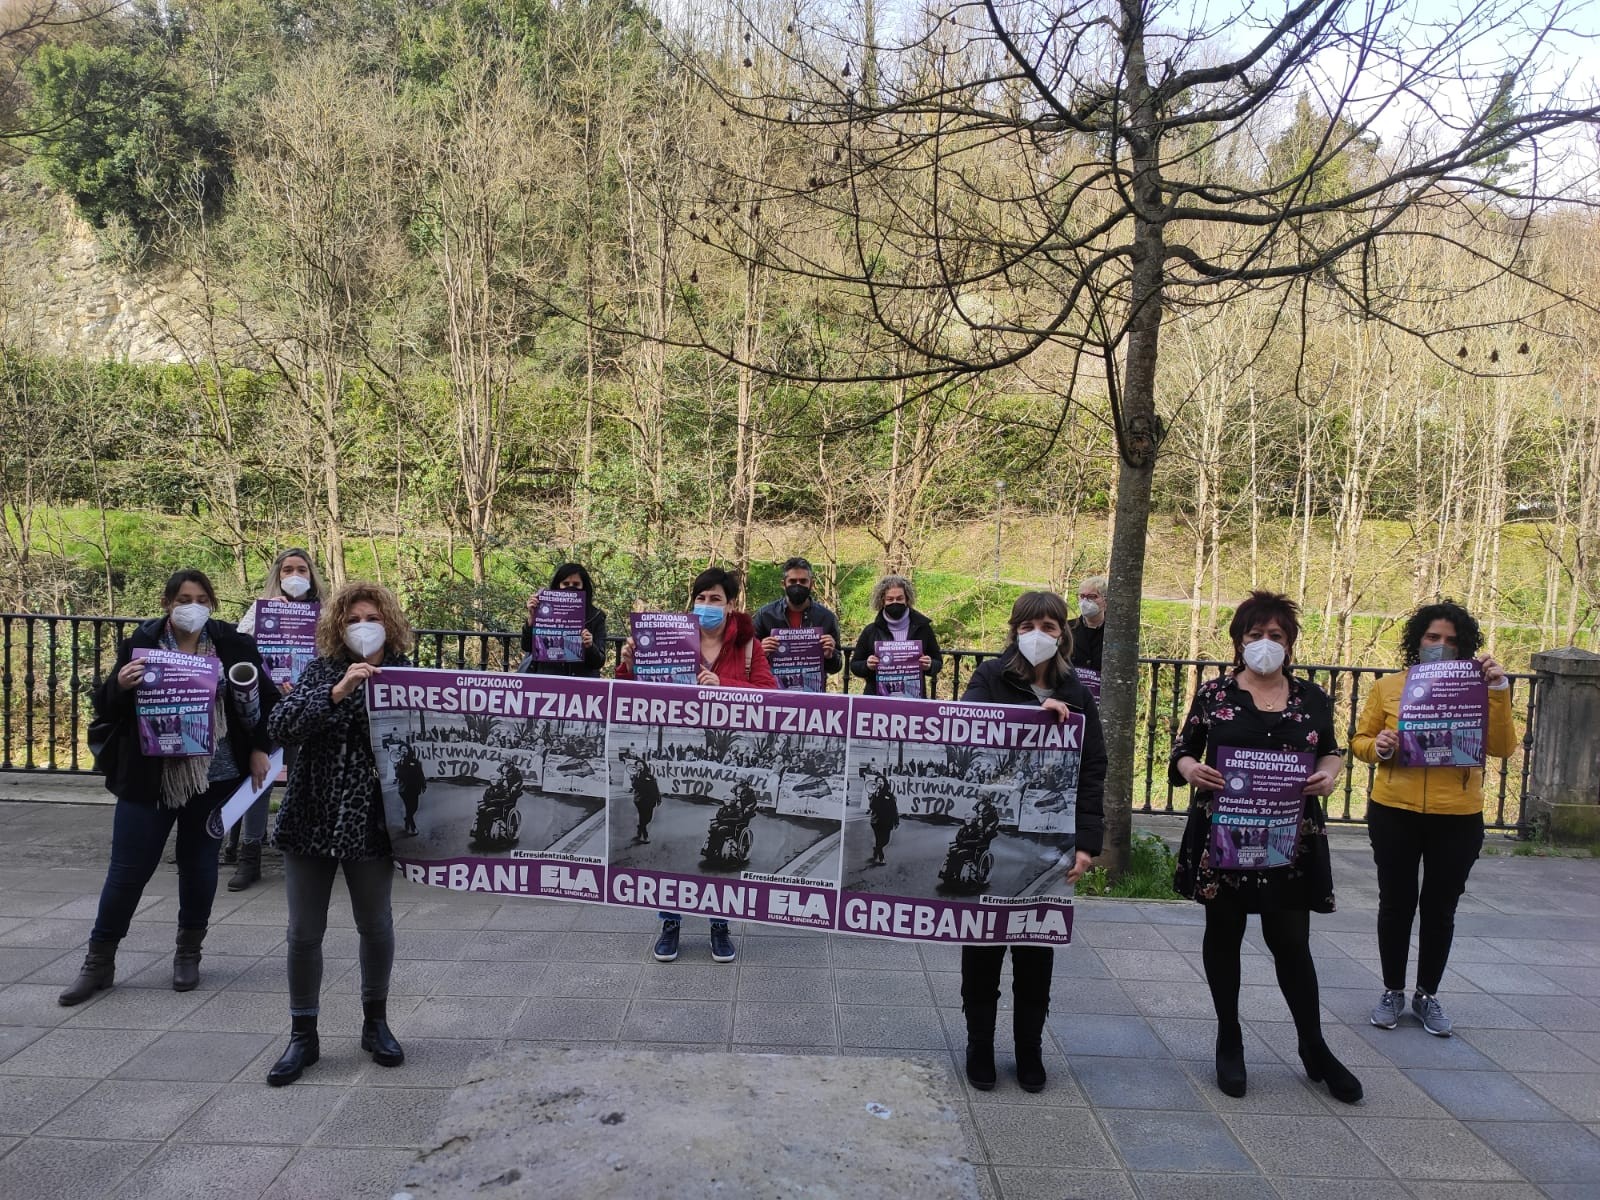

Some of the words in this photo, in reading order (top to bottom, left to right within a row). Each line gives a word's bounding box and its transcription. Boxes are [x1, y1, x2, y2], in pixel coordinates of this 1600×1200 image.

[642, 614, 687, 622] GIPUZKOAKO
[149, 651, 205, 662] GIPUZKOAKO
[671, 665, 694, 674] goaz!
[1419, 662, 1472, 672] GIPUZKOAKO
[1411, 671, 1480, 680] ERRESIDENTZIAK
[457, 677, 523, 689] GIPUZKOAKO
[374, 683, 604, 720] ERRESIDENTZIAK
[698, 690, 763, 703] GIPUZKOAKO
[140, 706, 176, 714] Grebara
[179, 703, 208, 714] goaz!
[938, 706, 1005, 720] GIPUZKOAKO
[615, 697, 845, 734] ERRESIDENTZIAK
[856, 712, 1079, 748] ERRESIDENTZIAK
[1404, 722, 1447, 730] Grebara
[1451, 719, 1481, 729] goaz!
[1235, 750, 1298, 763] GIPUZKOAKO
[437, 761, 479, 775] STOP
[1225, 759, 1307, 773] ERRESIDENTZIAK
[672, 780, 713, 796] STOP
[911, 797, 954, 814] STOP
[1219, 797, 1254, 805] Otsailak
[1219, 806, 1257, 814] Martxoak
[1219, 815, 1265, 826] Grebara
[1268, 814, 1297, 827] goaz!
[513, 850, 602, 864] #ErresidentziakBorrokan
[540, 865, 599, 893] ELA
[743, 872, 834, 888] #ErresidentziakBorrokan
[540, 887, 562, 895] EUSKAL
[564, 889, 599, 898] SINDIKATUA
[612, 874, 758, 917] GREBAN!
[768, 889, 830, 920] ELA
[982, 896, 1072, 905] #ErresidentziakBorrokan
[793, 916, 829, 926] SINDIKATUA
[844, 898, 997, 939] GREBAN!
[1006, 909, 1068, 935] ELA
